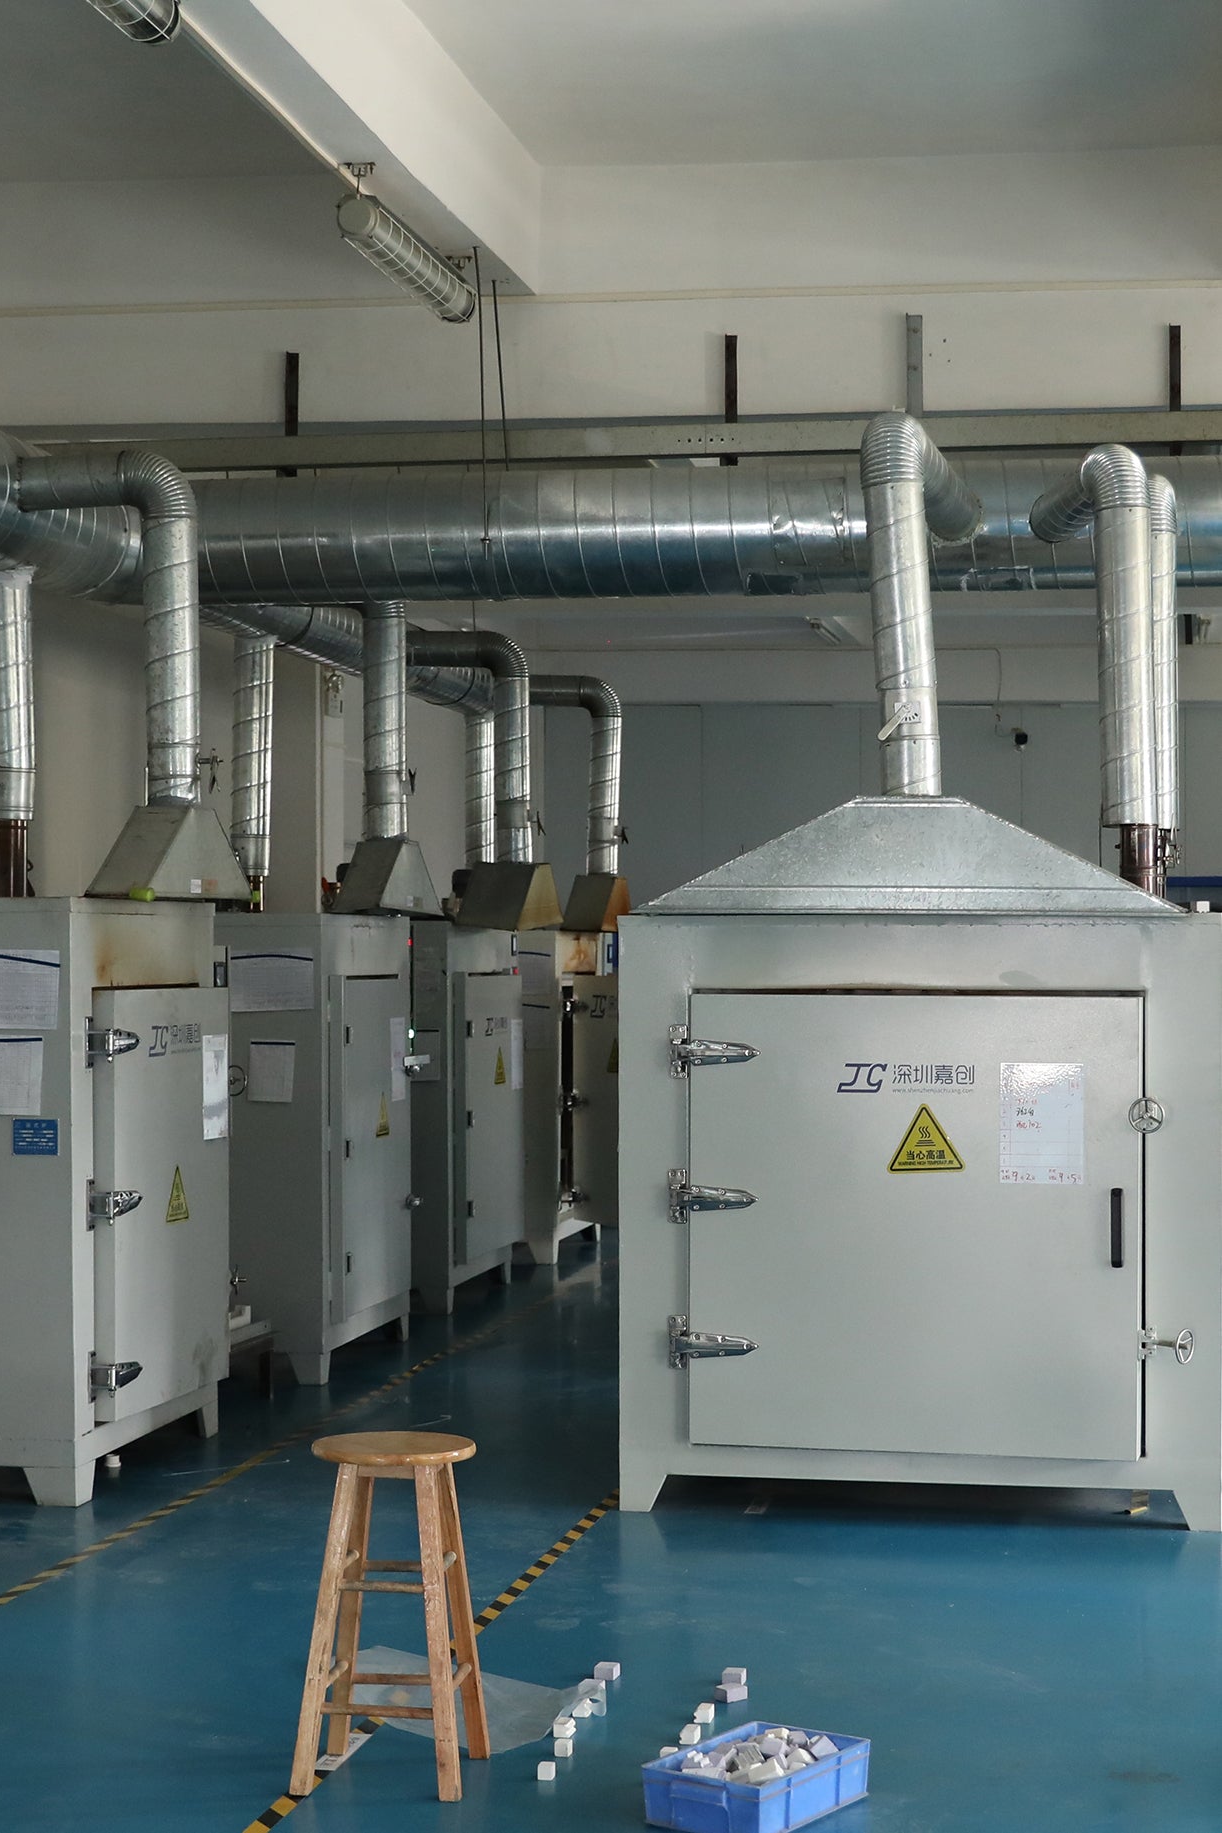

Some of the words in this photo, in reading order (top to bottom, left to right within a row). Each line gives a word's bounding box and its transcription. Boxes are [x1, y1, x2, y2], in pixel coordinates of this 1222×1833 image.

[892, 1063, 975, 1085] 深圳嘉创
[906, 1149, 946, 1160] 当心高温
